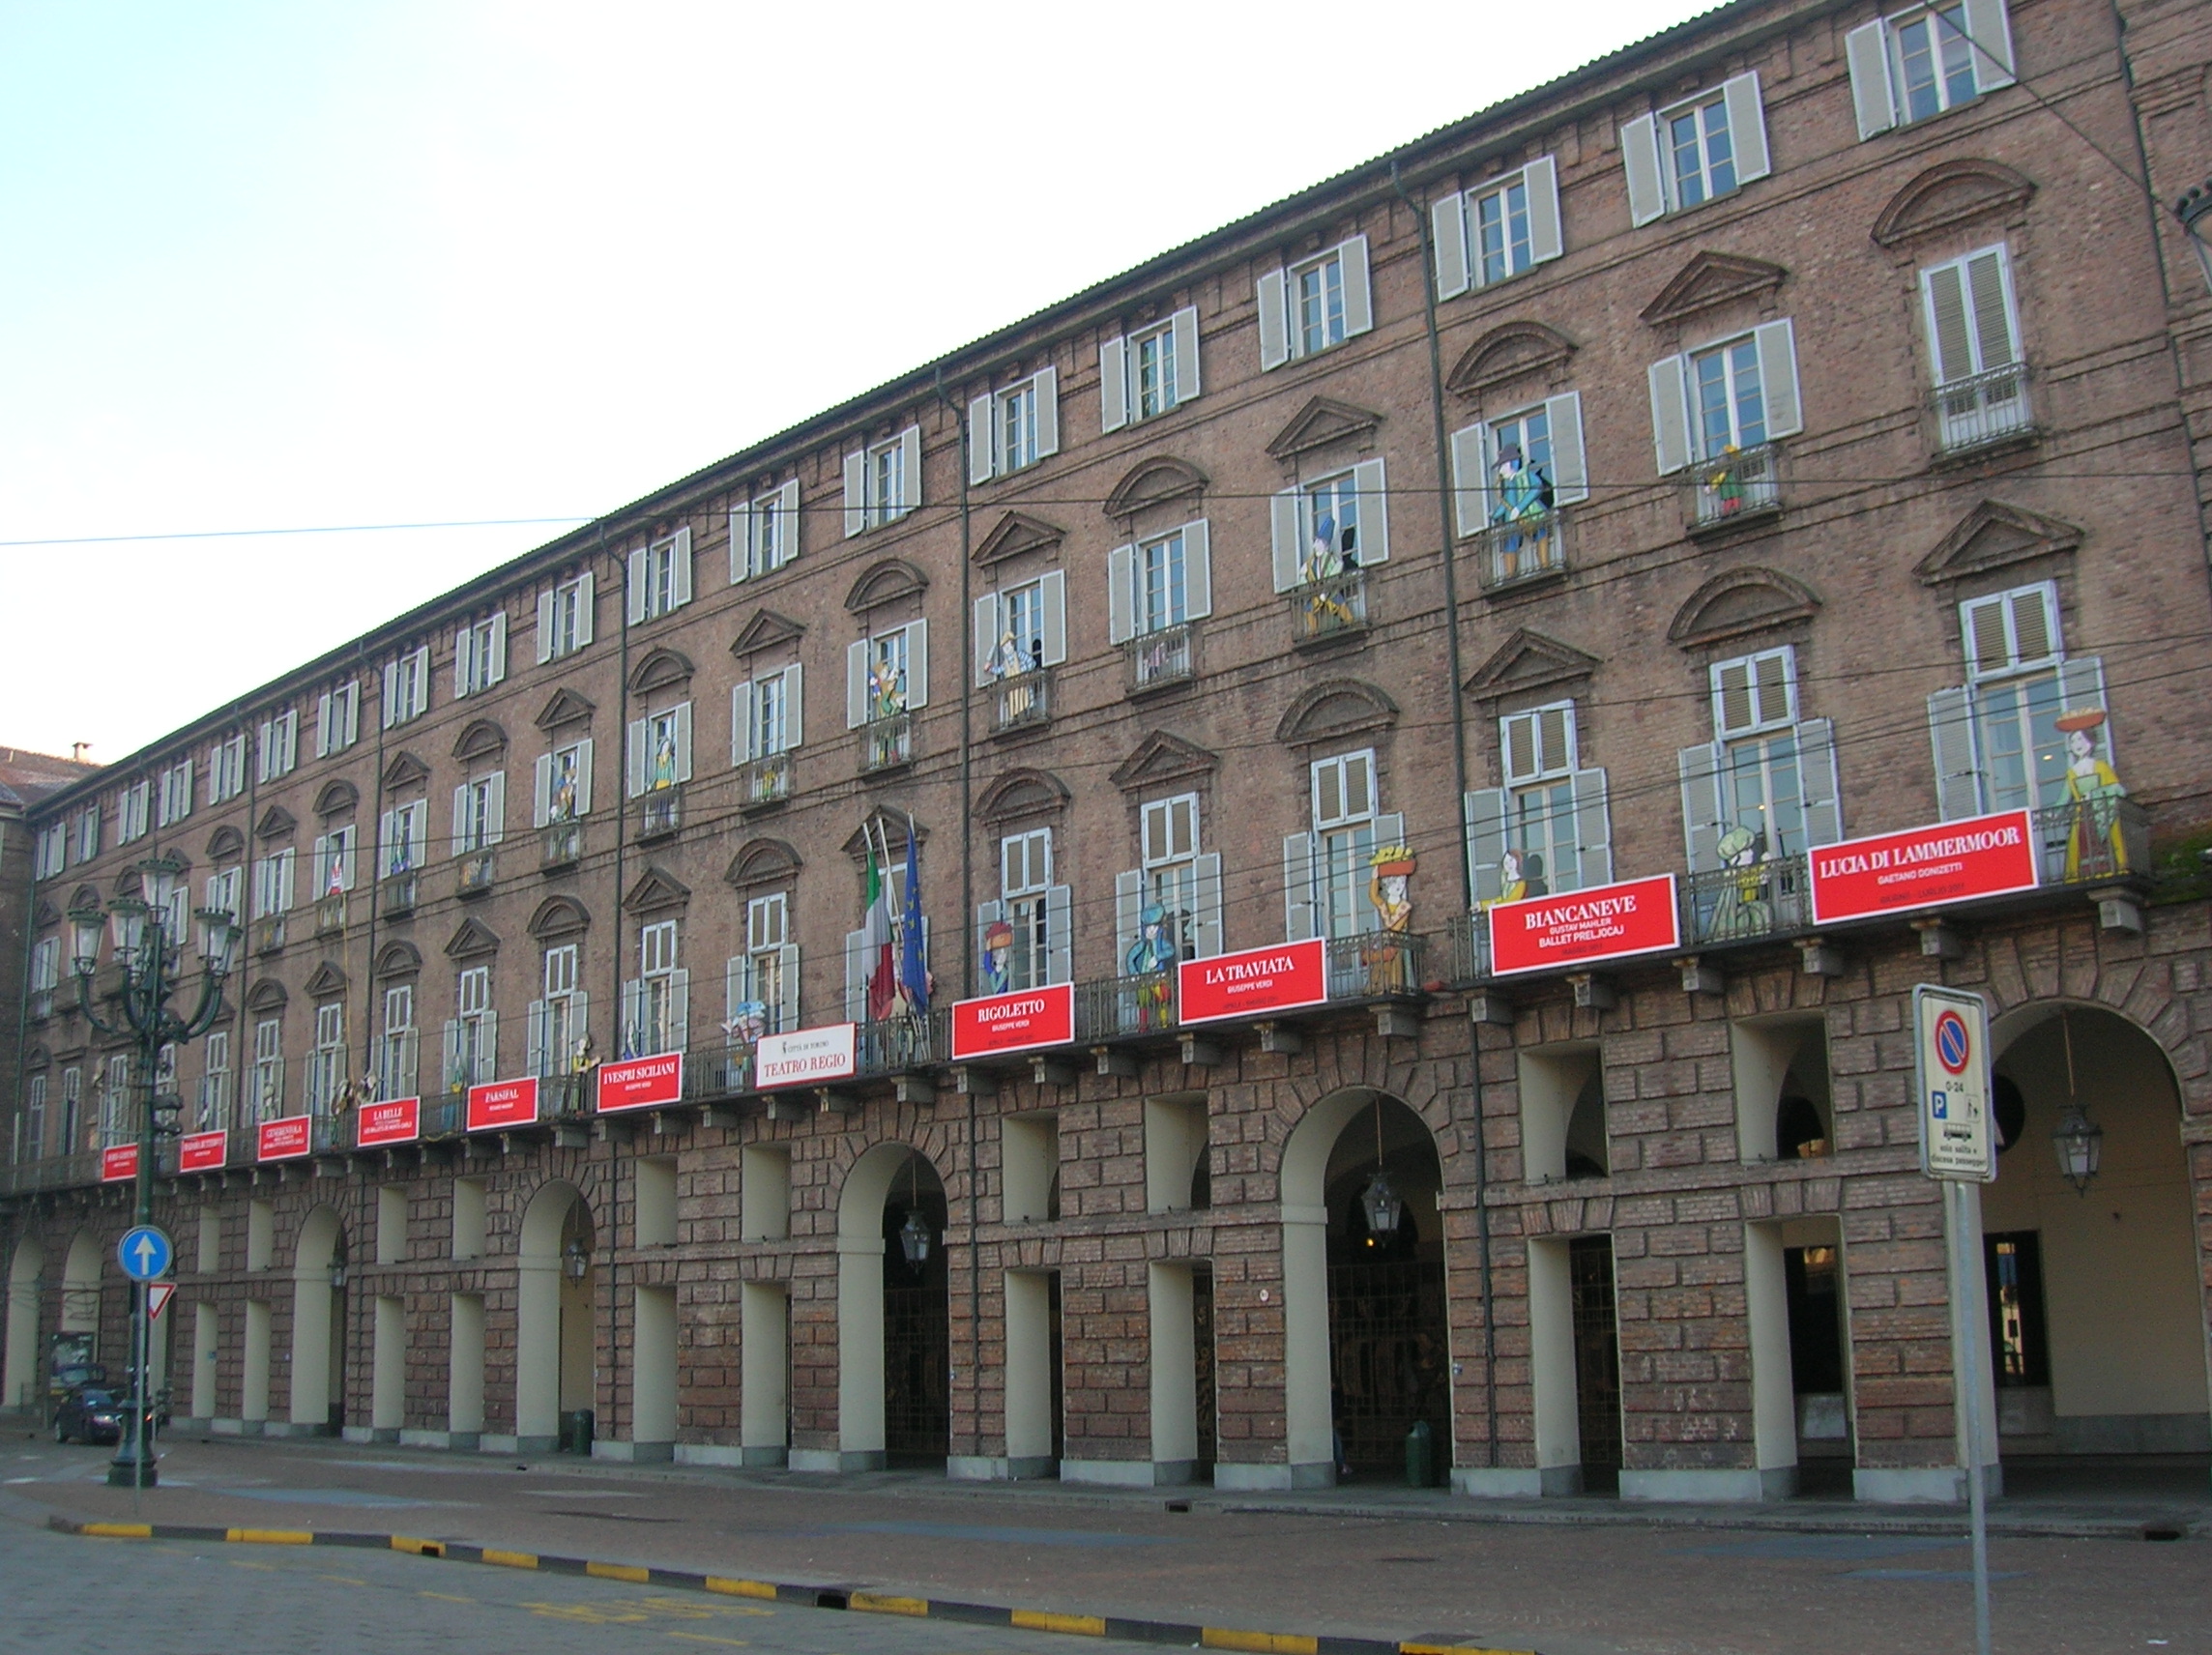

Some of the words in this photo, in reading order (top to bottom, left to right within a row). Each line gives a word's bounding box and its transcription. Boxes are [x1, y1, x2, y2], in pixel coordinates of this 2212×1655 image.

[1819, 857, 1869, 879] LUCIA
[1871, 851, 1888, 869] DI
[1894, 826, 2021, 865] LAMMERMOOR
[1877, 870, 1916, 886] GAETANO
[1918, 861, 1963, 879] DONIZETTI
[1525, 895, 1637, 930] BIANCANEVE
[1539, 933, 1572, 947] BALLET
[1573, 925, 1624, 943] PRELJOCAJ
[1550, 922, 1578, 935] GUSTAV
[1580, 917, 1612, 931] MAHLER
[1206, 968, 1224, 984] LA
[1226, 955, 1295, 980] TRAVIATA
[1227, 983, 1255, 995] GIUSEPPE
[1256, 979, 1273, 991] VERDI
[977, 999, 1045, 1023] RIGOLETTO
[608, 1067, 635, 1084] VESPRI
[636, 1061, 676, 1080] SICILIANI
[764, 1058, 807, 1078] TEATRO
[810, 1052, 846, 1070] REGIO
[1934, 1094, 1945, 1115] P
